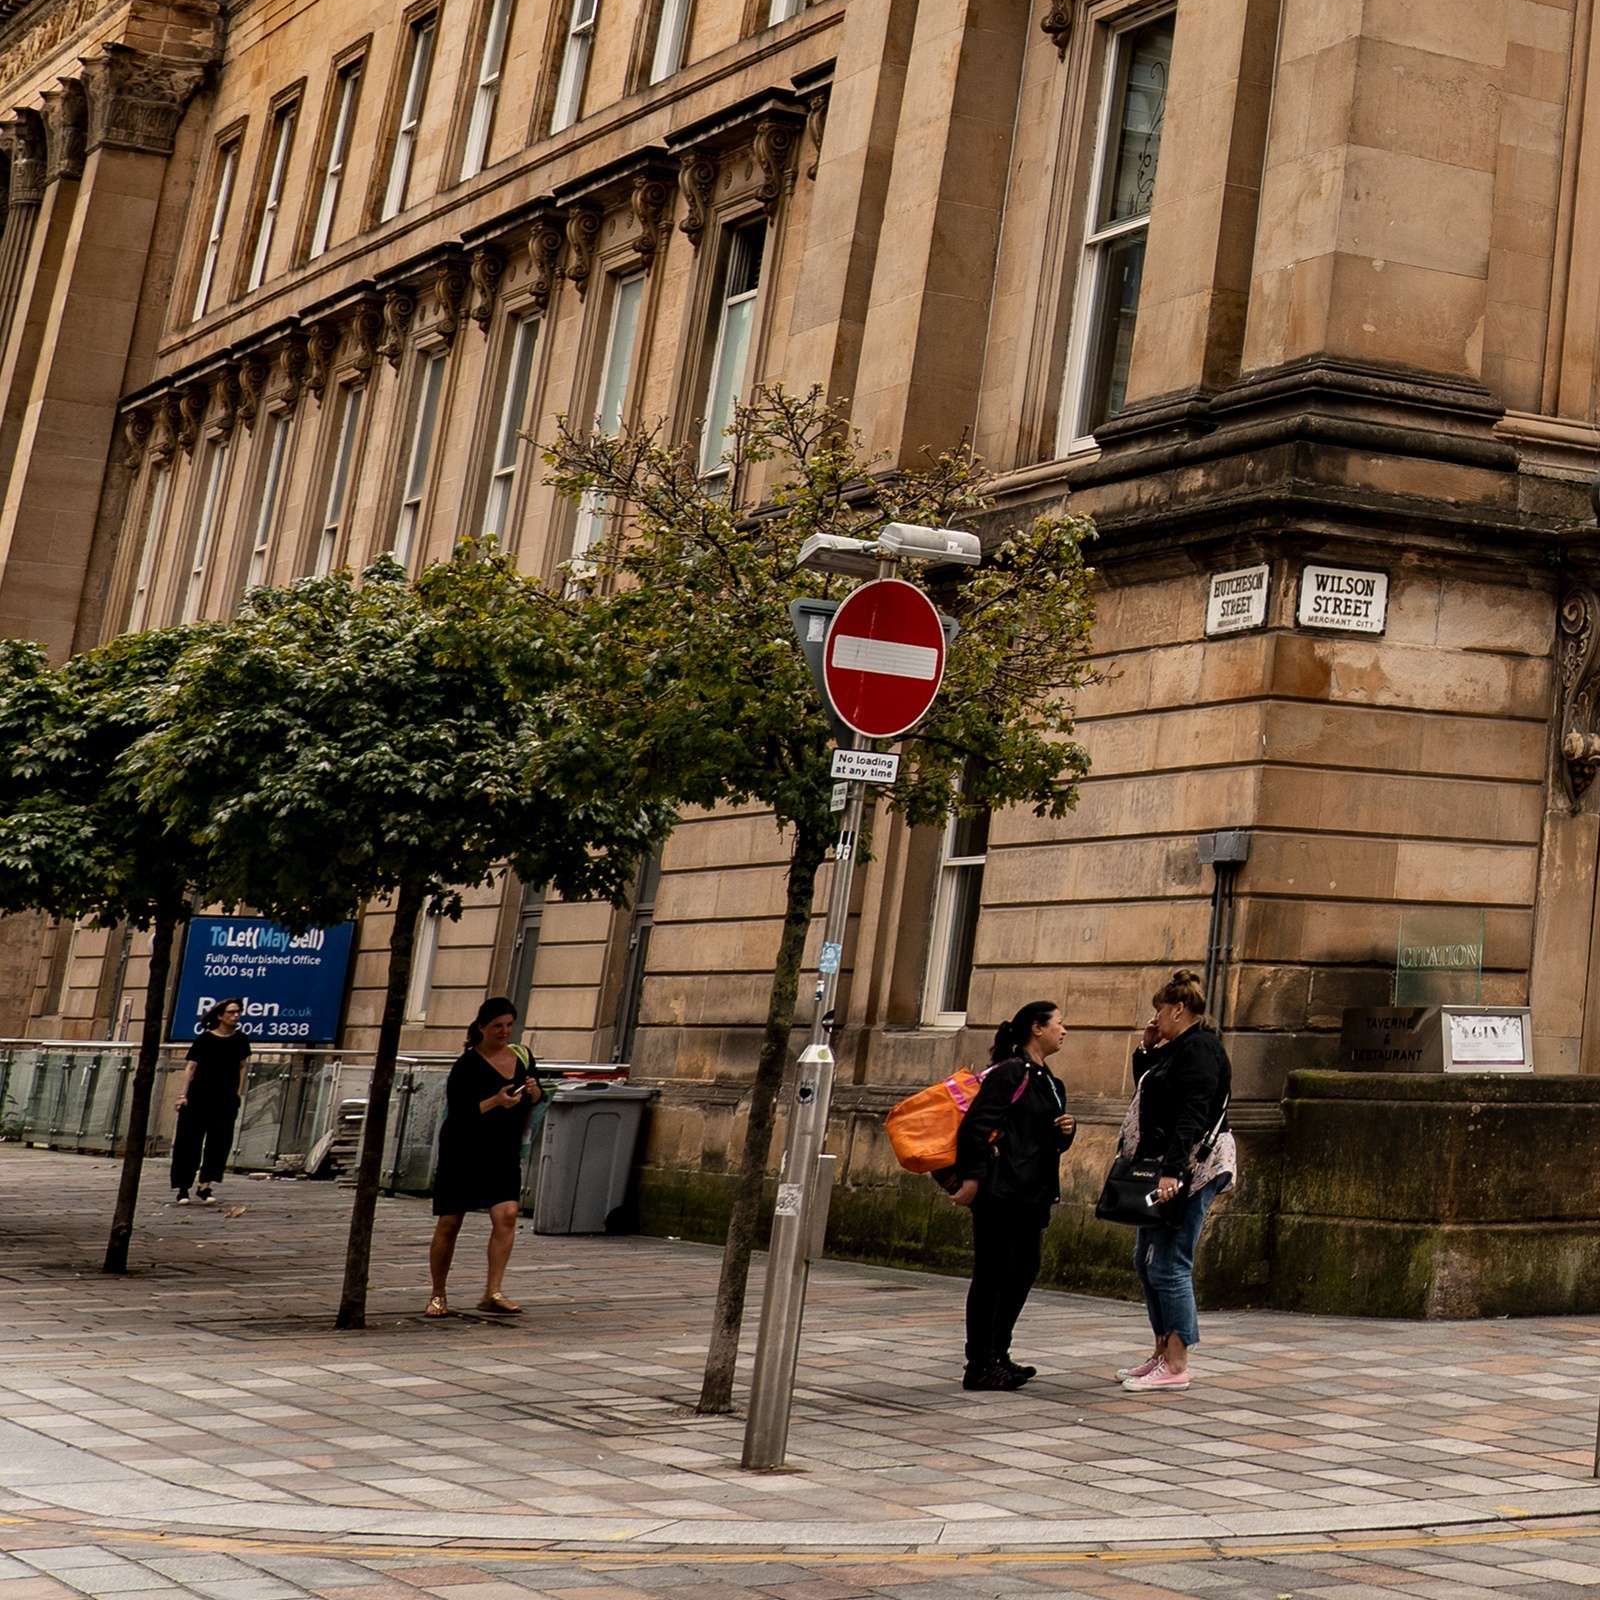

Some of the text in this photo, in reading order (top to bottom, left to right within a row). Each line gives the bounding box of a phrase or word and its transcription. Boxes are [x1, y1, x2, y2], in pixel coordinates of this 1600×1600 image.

[1213, 571, 1264, 598] HUTCHESON
[1315, 573, 1376, 597] WILSON
[1220, 595, 1253, 617] STREET
[1312, 595, 1373, 618] STREET
[1307, 615, 1375, 629] MERCHANT CITY
[838, 754, 893, 769] No loading
[835, 766, 892, 778] at any time
[205, 953, 321, 965] Fully Refurbished Office
[1400, 944, 1477, 968] CITATION
[203, 965, 267, 978] 7,000 sq ft
[267, 1022, 310, 1036] 3838
